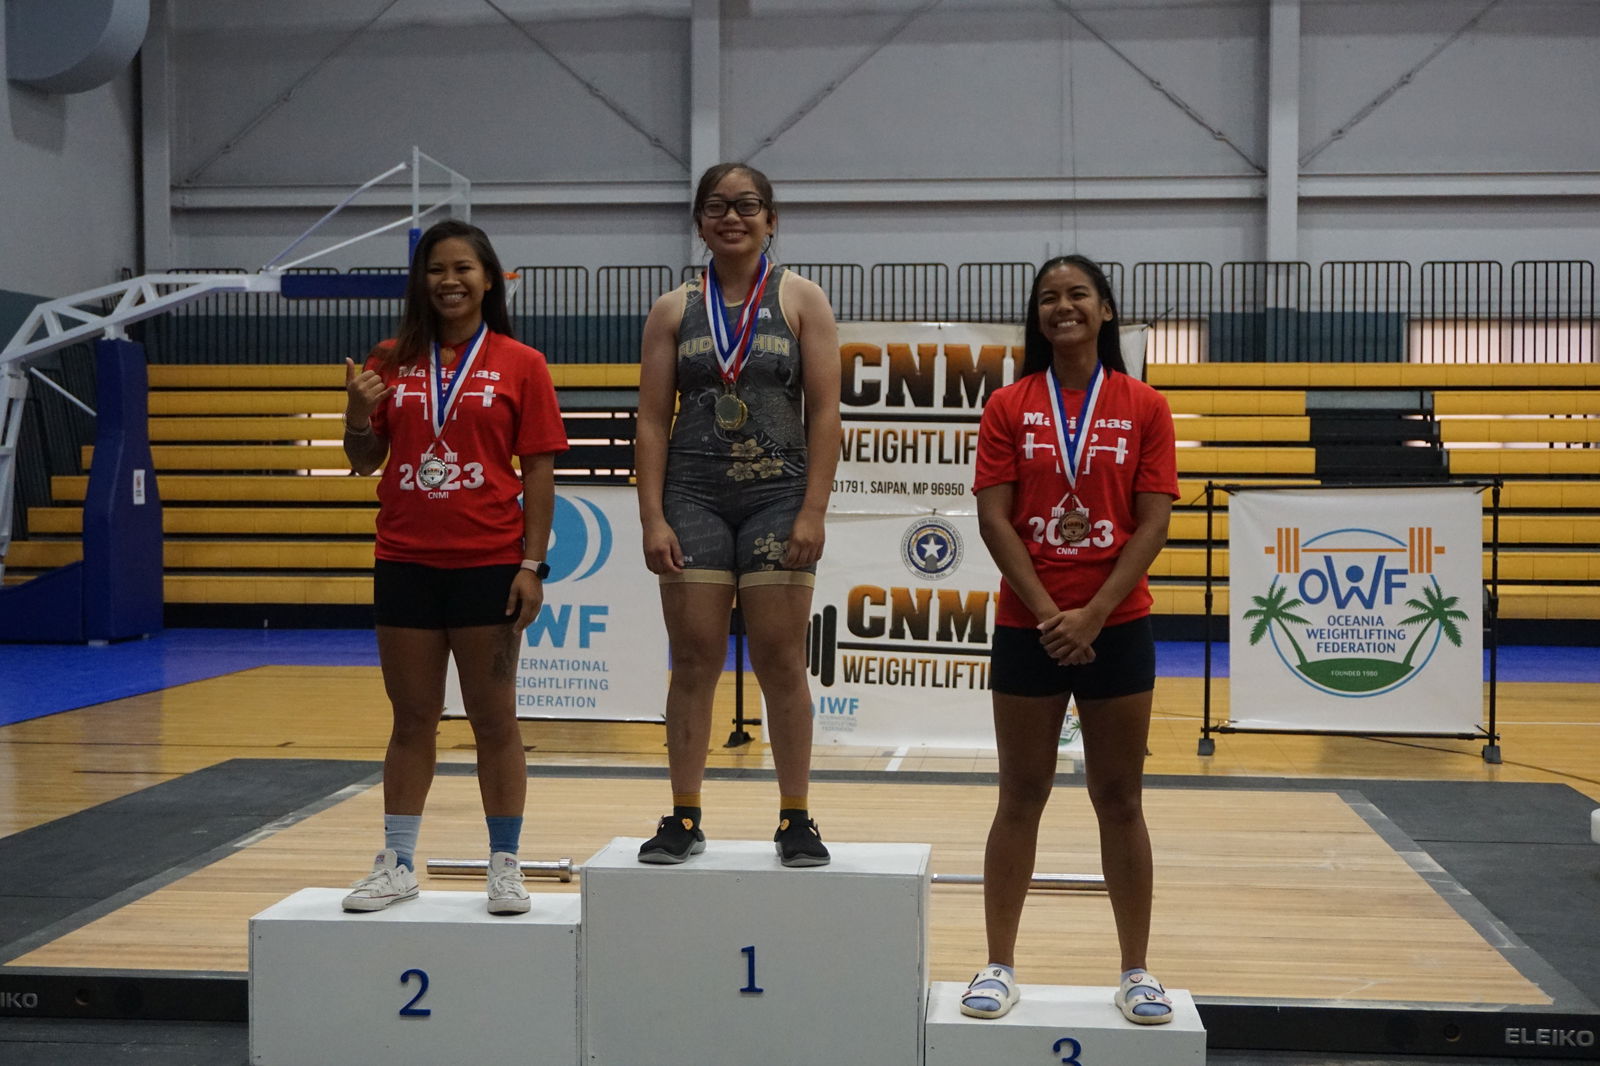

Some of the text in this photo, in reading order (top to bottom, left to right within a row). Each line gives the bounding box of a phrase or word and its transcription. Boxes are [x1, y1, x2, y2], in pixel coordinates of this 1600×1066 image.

[400, 462, 485, 491] 223
[428, 491, 449, 500] CNMI
[870, 480, 910, 495] SAIPAN,
[913, 482, 928, 494] MP
[931, 483, 965, 496] 96950
[1056, 547, 1078, 556] CNMI
[1298, 555, 1409, 610] OWF
[1327, 615, 1384, 627] OCEANIA
[1306, 628, 1406, 641] WEIGHTLIFTING
[1316, 642, 1396, 654] FEDERATION
[820, 696, 860, 715] IWF
[740, 945, 763, 993] 1
[399, 968, 431, 1017] 2
[1504, 1027, 1595, 1047] ELEIKO
[1052, 1037, 1082, 1066] 3
